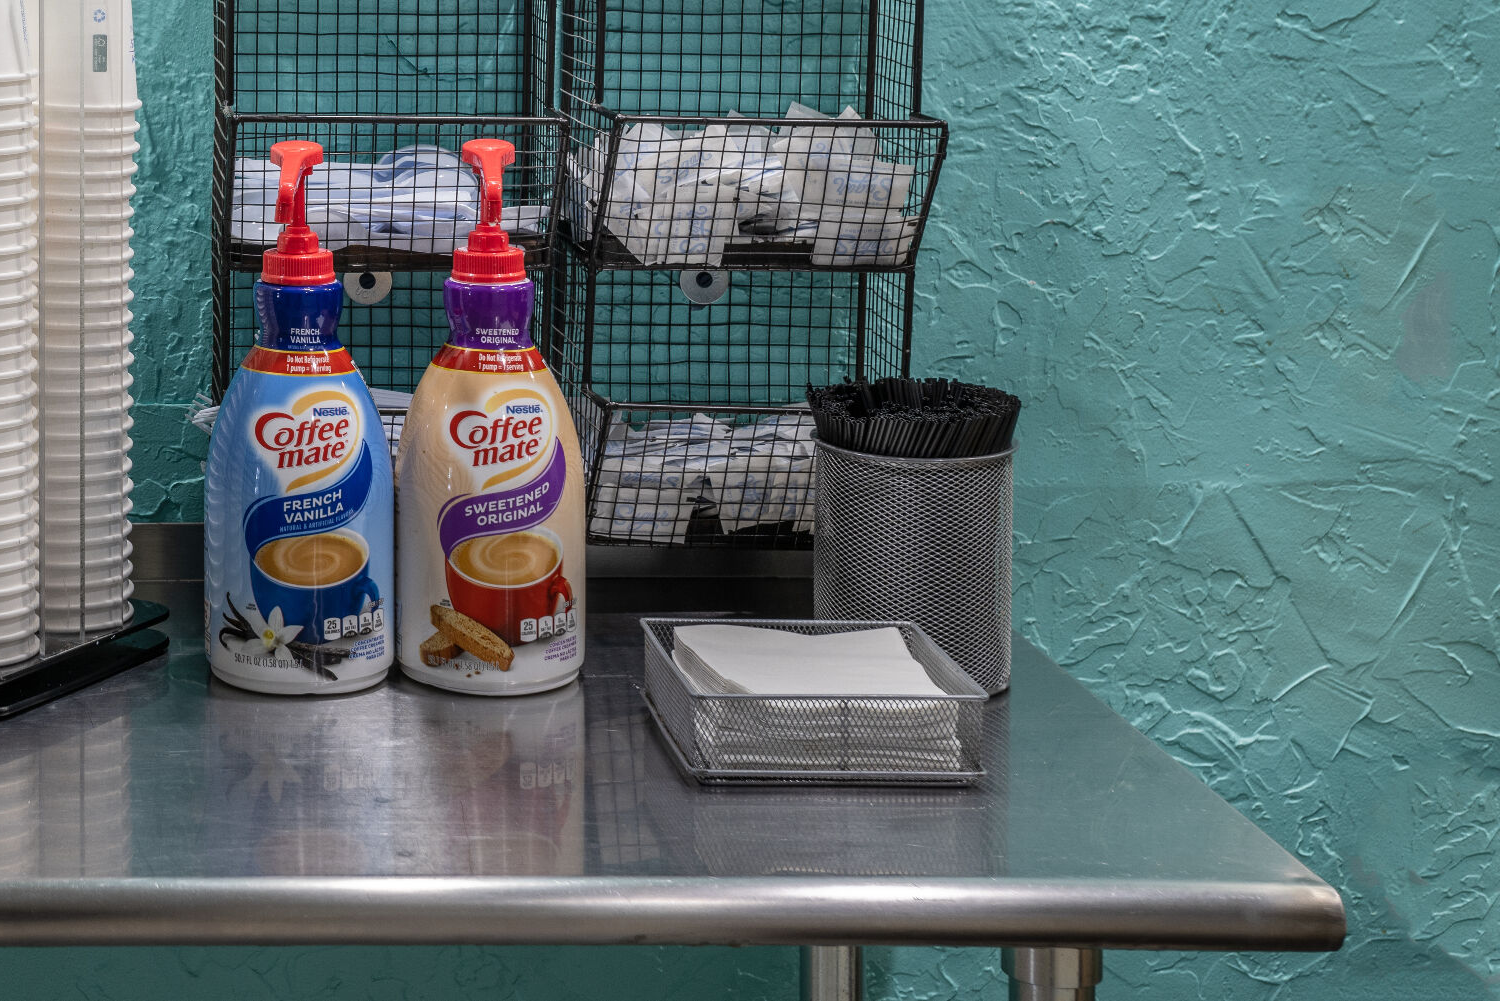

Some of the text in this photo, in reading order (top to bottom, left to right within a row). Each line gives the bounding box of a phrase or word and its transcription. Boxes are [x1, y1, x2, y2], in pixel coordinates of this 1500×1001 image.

[290, 336, 322, 344] VANILLA
[480, 336, 516, 344] ORIGINAL
[482, 364, 497, 372] pump
[255, 412, 349, 451] Coffee
[449, 410, 542, 449] Coffee
[277, 441, 345, 468] mate
[472, 439, 539, 466] mate
[283, 489, 342, 512] FRENCH
[464, 482, 550, 517] SWEETENED
[284, 502, 344, 524] VANILLA
[476, 502, 543, 526] ORIGINAL
[327, 620, 337, 630] 25
[523, 621, 533, 631] 25
[246, 655, 252, 665] FL
[253, 656, 261, 666] OZ
